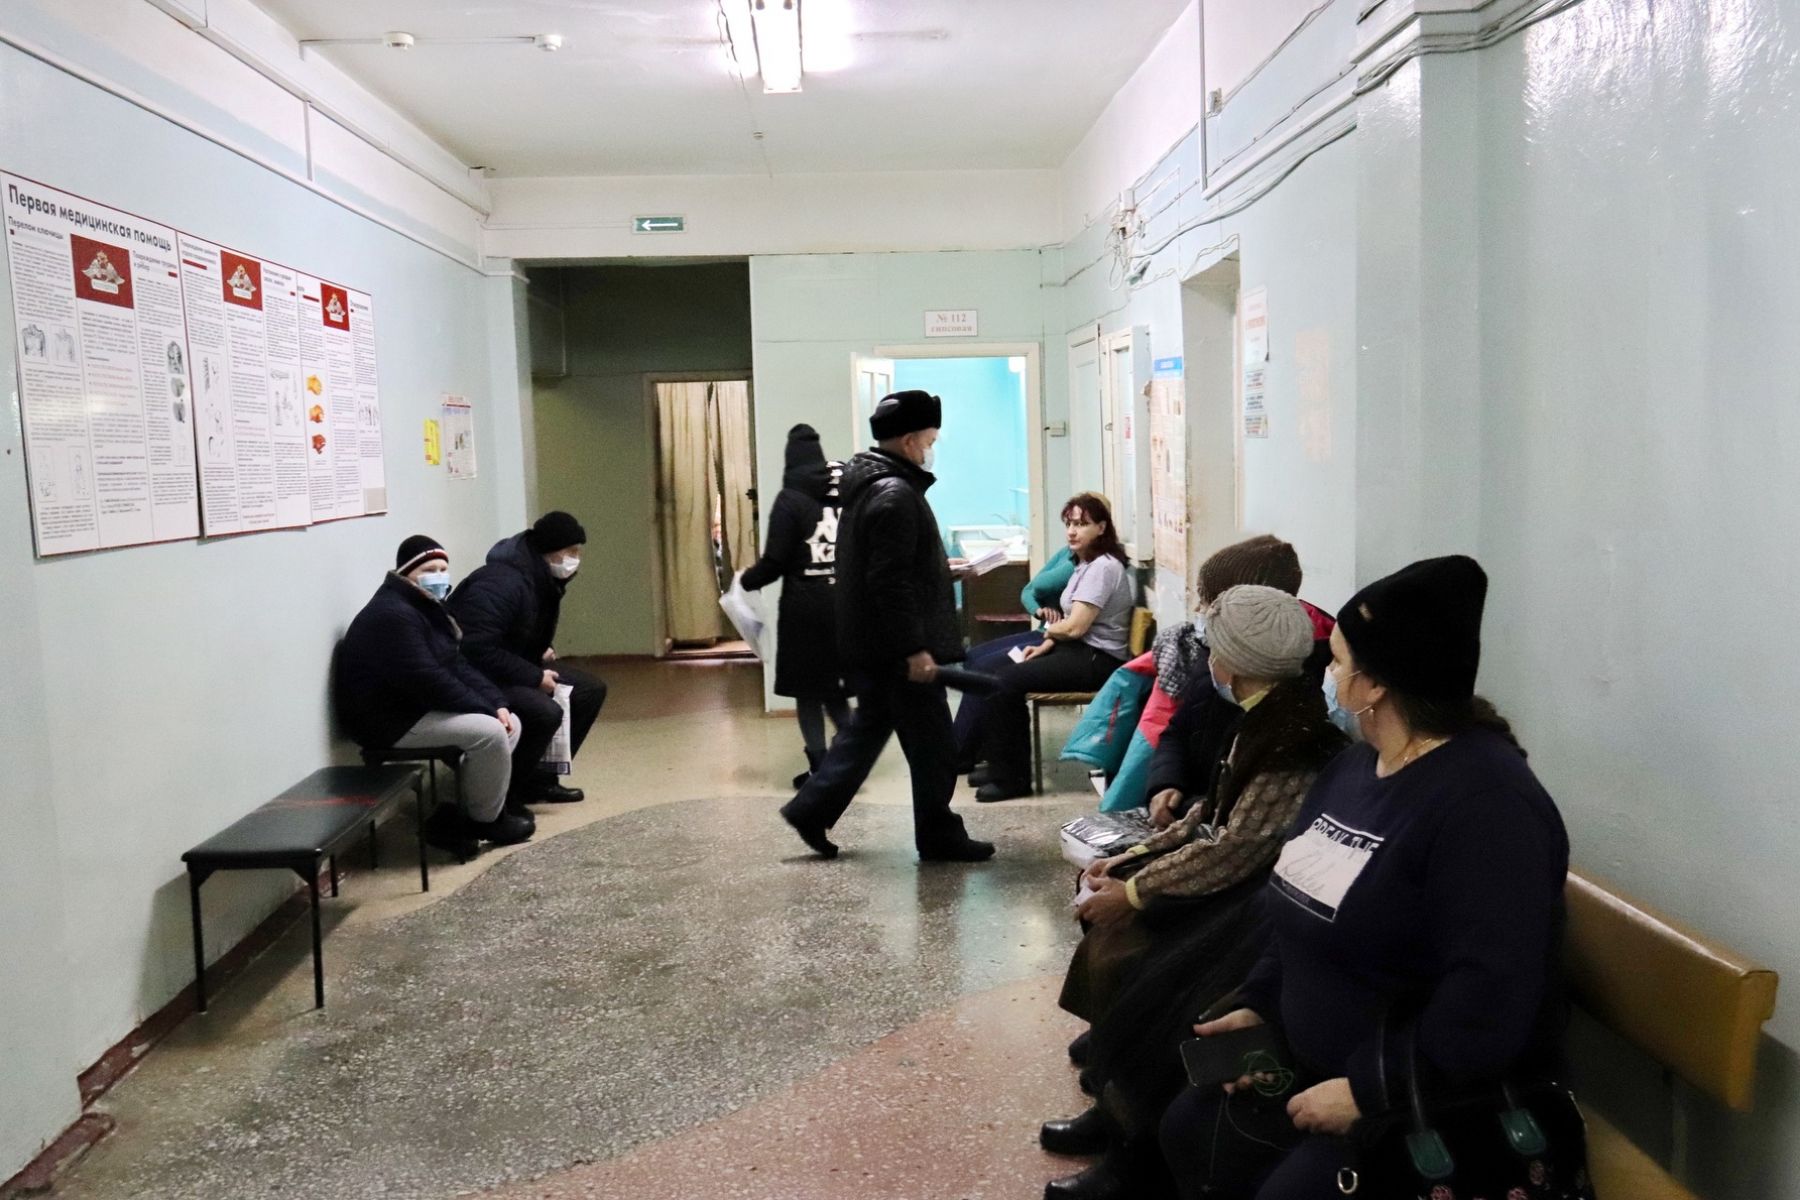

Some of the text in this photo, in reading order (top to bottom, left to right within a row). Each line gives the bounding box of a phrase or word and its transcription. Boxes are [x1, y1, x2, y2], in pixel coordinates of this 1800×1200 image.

[8, 184, 57, 216] Первая
[59, 206, 132, 239] медицинская
[134, 229, 172, 252] помощь
[951, 313, 967, 322] 112
